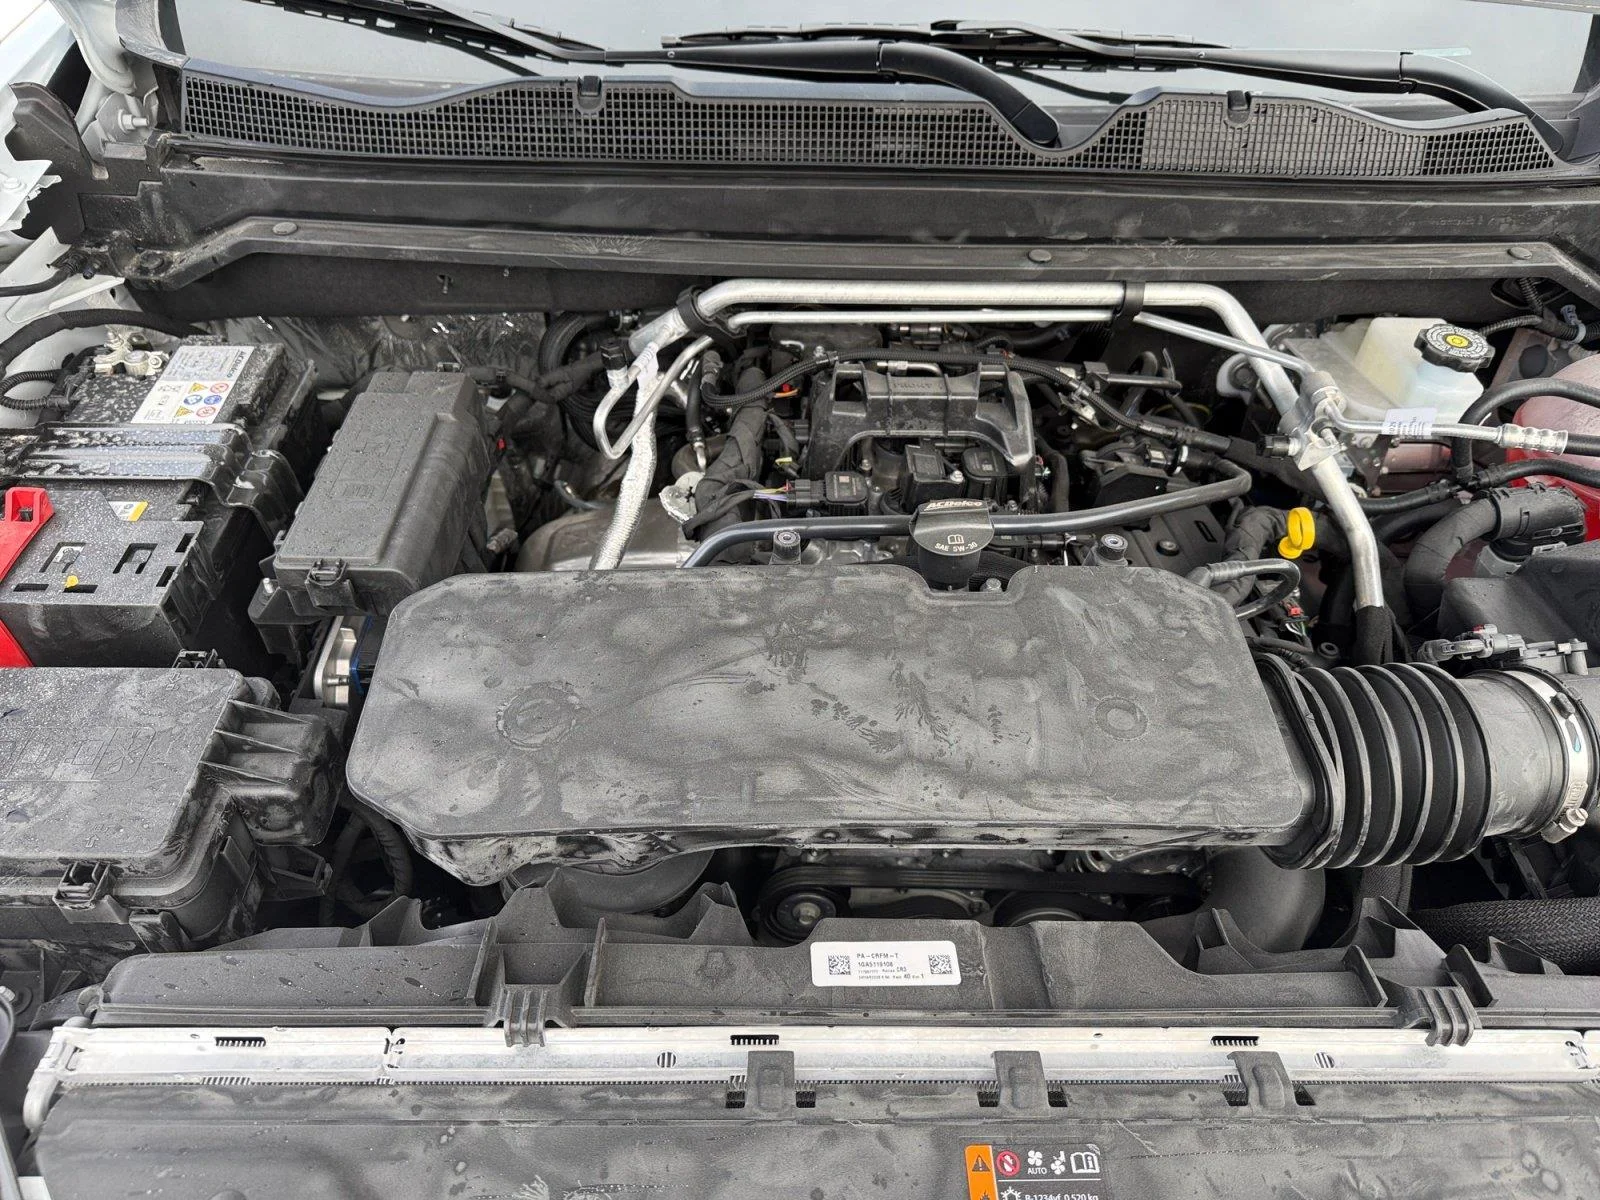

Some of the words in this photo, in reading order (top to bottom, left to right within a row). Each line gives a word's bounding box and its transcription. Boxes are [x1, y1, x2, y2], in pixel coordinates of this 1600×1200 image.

[924, 500, 983, 510] ACDelco
[934, 542, 949, 552] SAE
[952, 542, 978, 552] 5W-30
